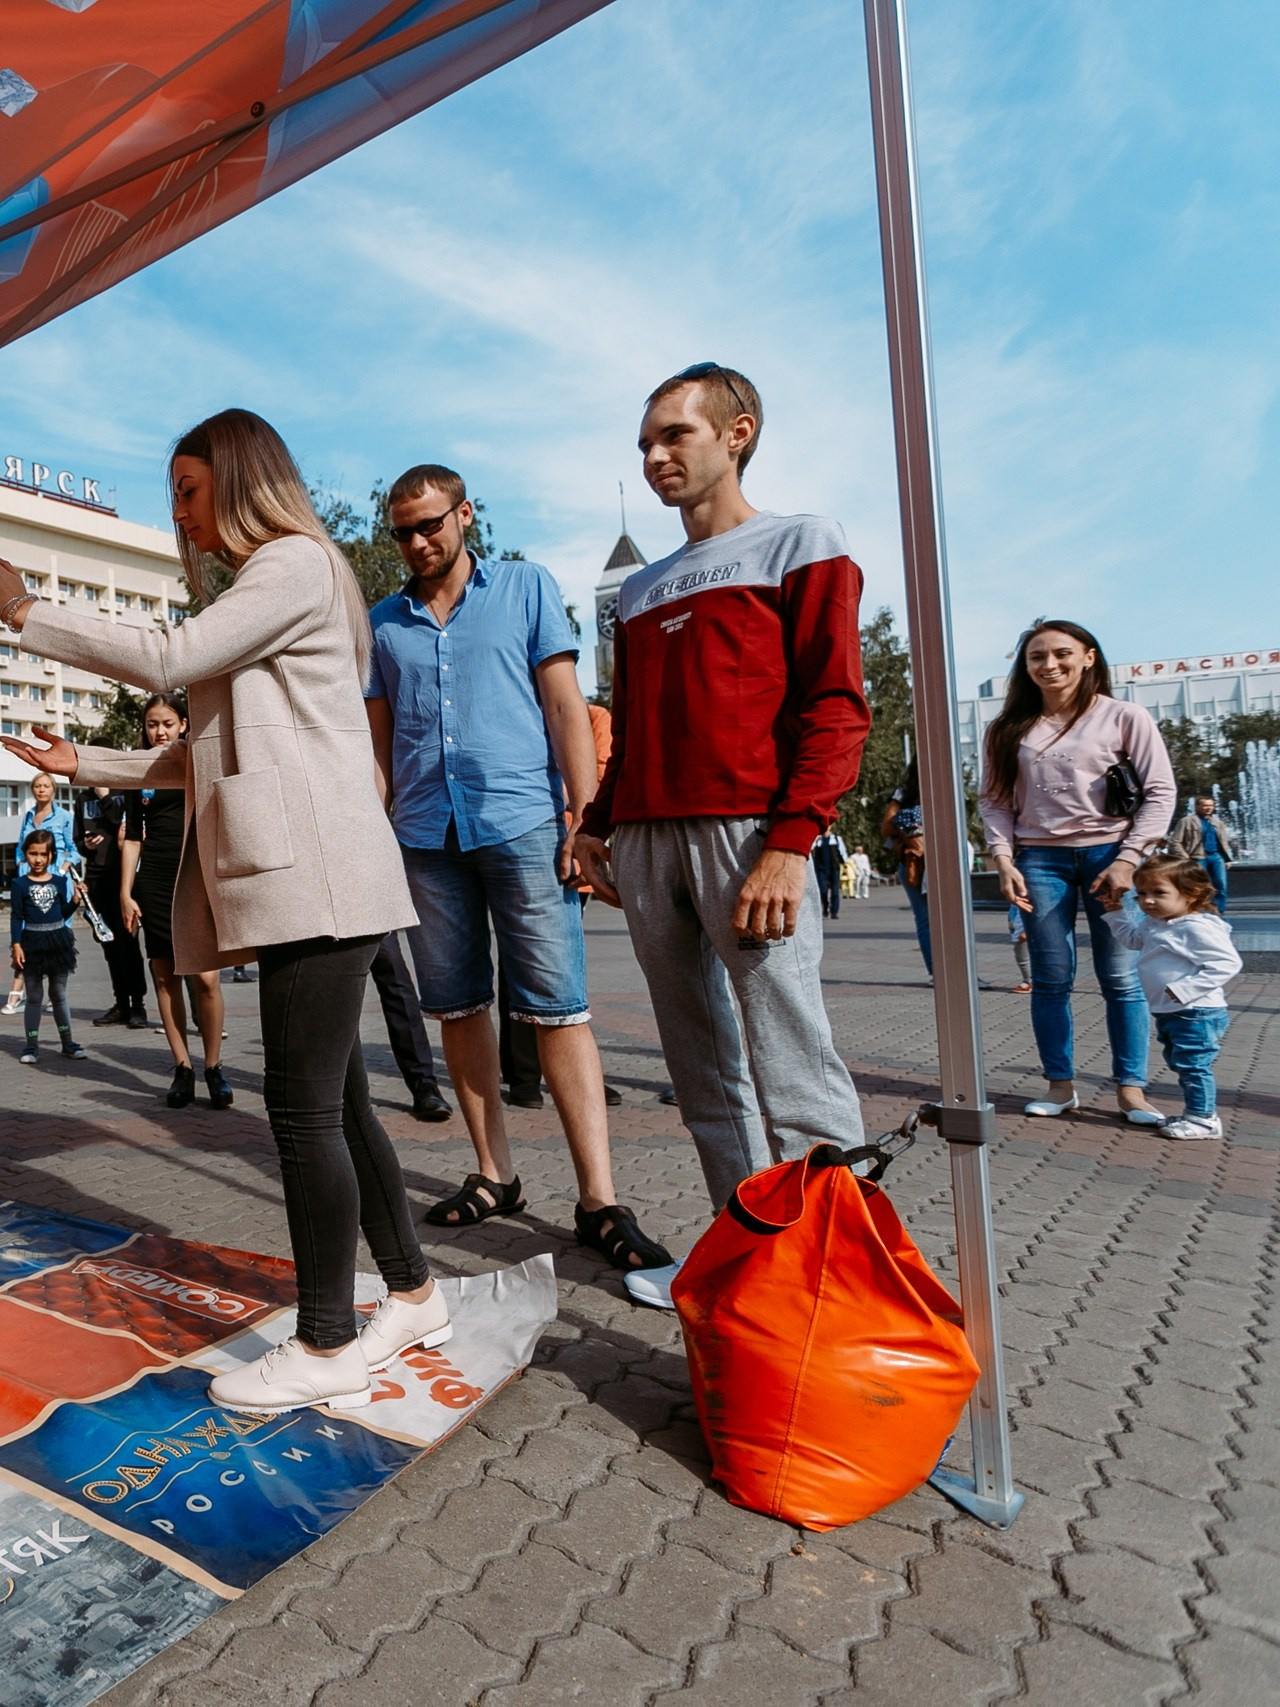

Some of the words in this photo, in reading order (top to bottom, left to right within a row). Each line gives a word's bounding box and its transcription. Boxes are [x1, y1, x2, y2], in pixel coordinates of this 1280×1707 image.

[1131, 651, 1280, 677] КРАСНОЯ
[87, 1262, 246, 1316] COMEDY
[81, 1411, 279, 1504] ОДНАЖД
[150, 1423, 345, 1535] РОССИИ
